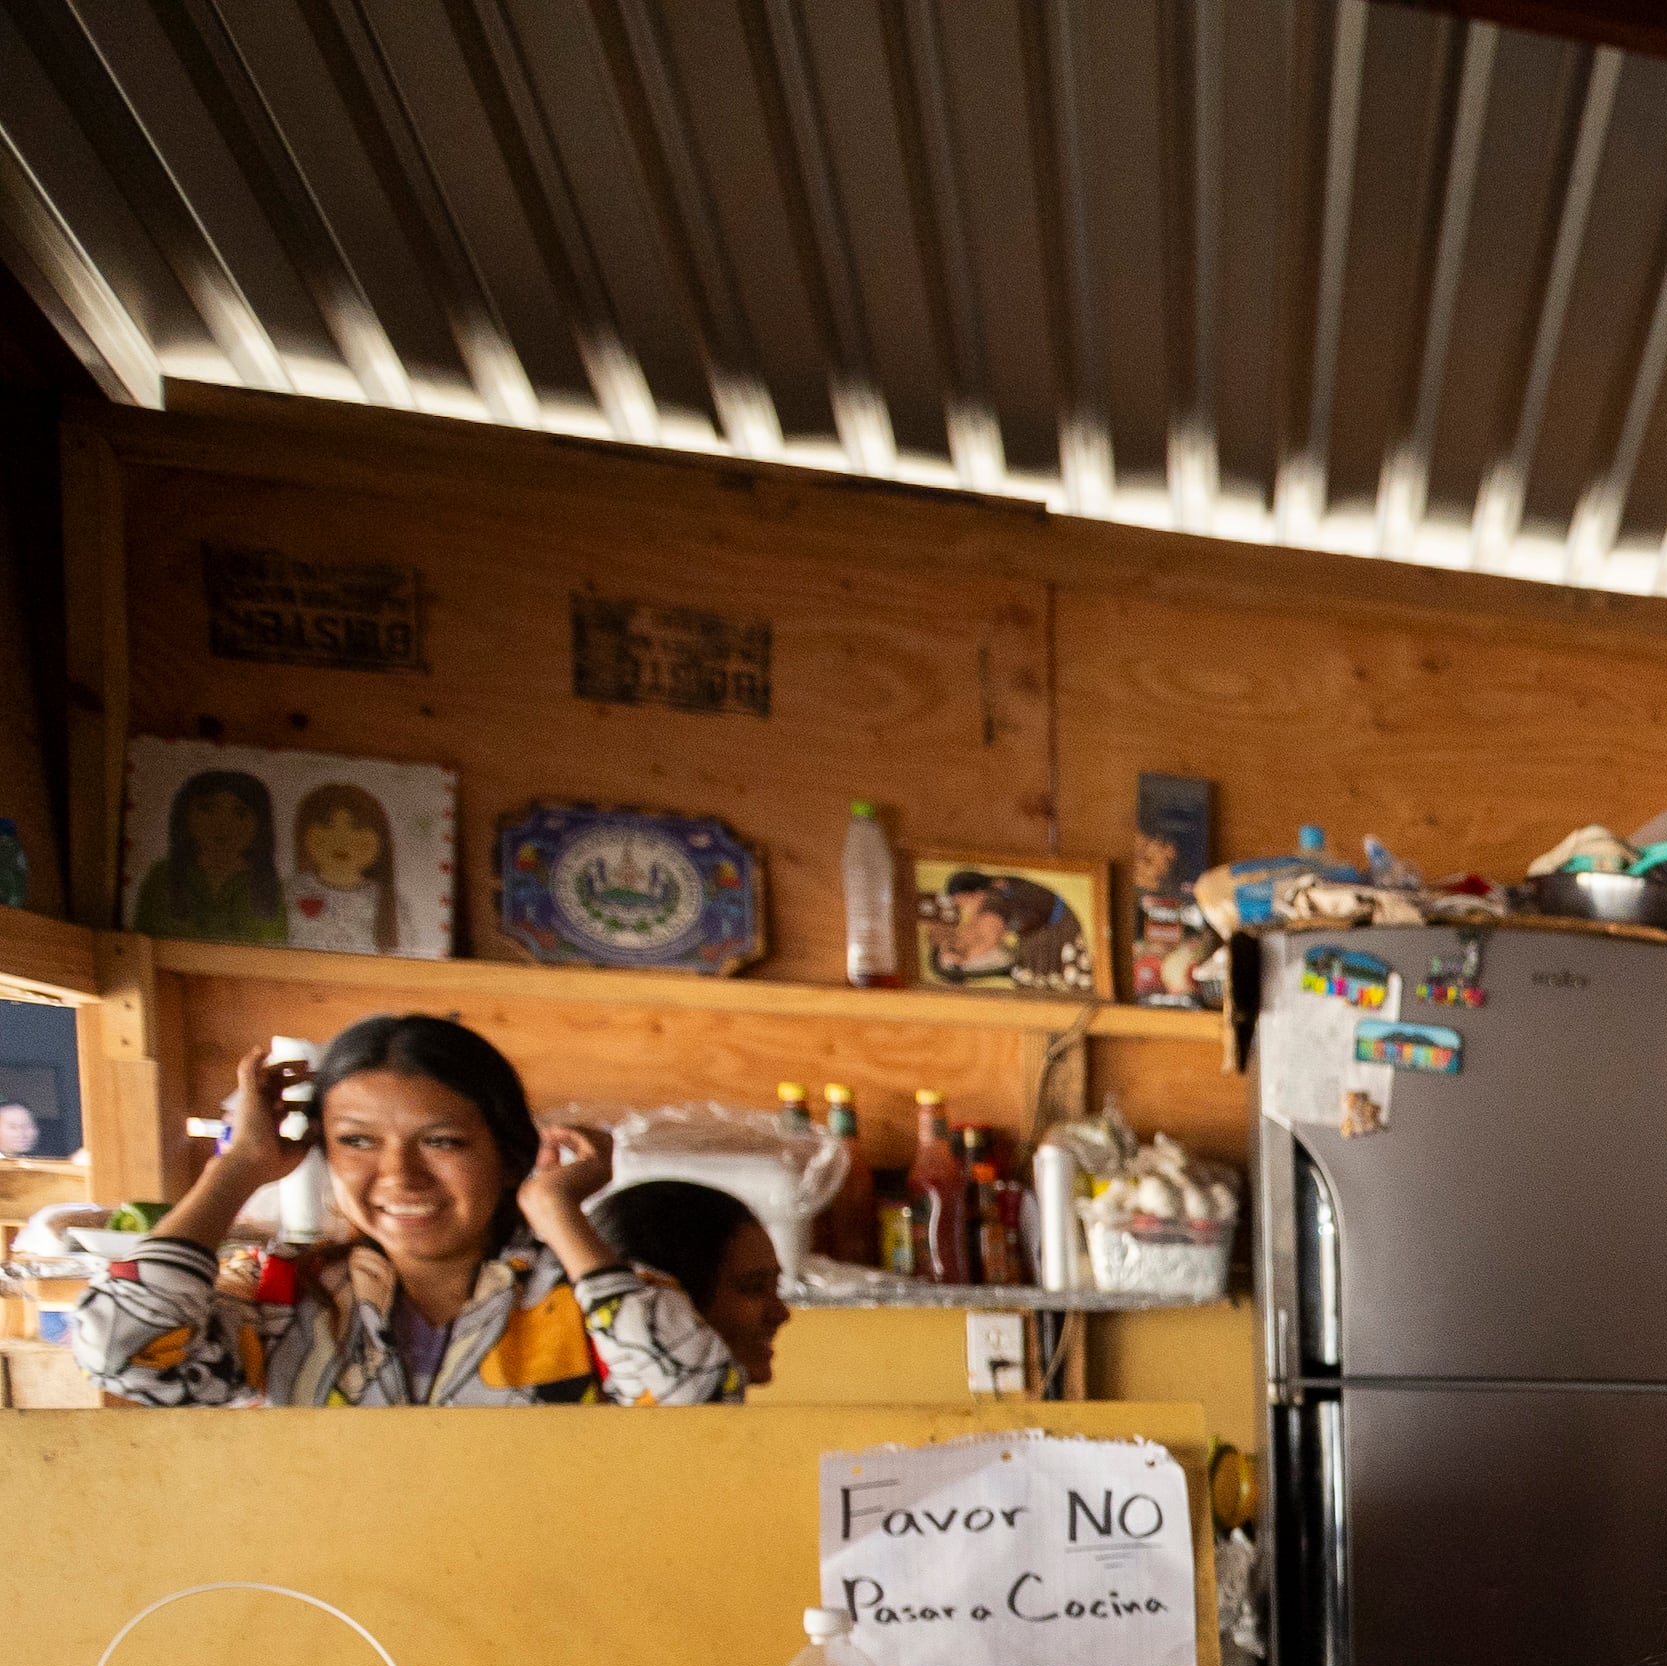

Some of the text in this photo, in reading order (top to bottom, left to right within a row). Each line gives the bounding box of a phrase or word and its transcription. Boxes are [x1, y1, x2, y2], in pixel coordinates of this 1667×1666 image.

[839, 1478, 1165, 1545] Favor NO
[843, 1571, 1169, 1625] Pasar a Cocina
